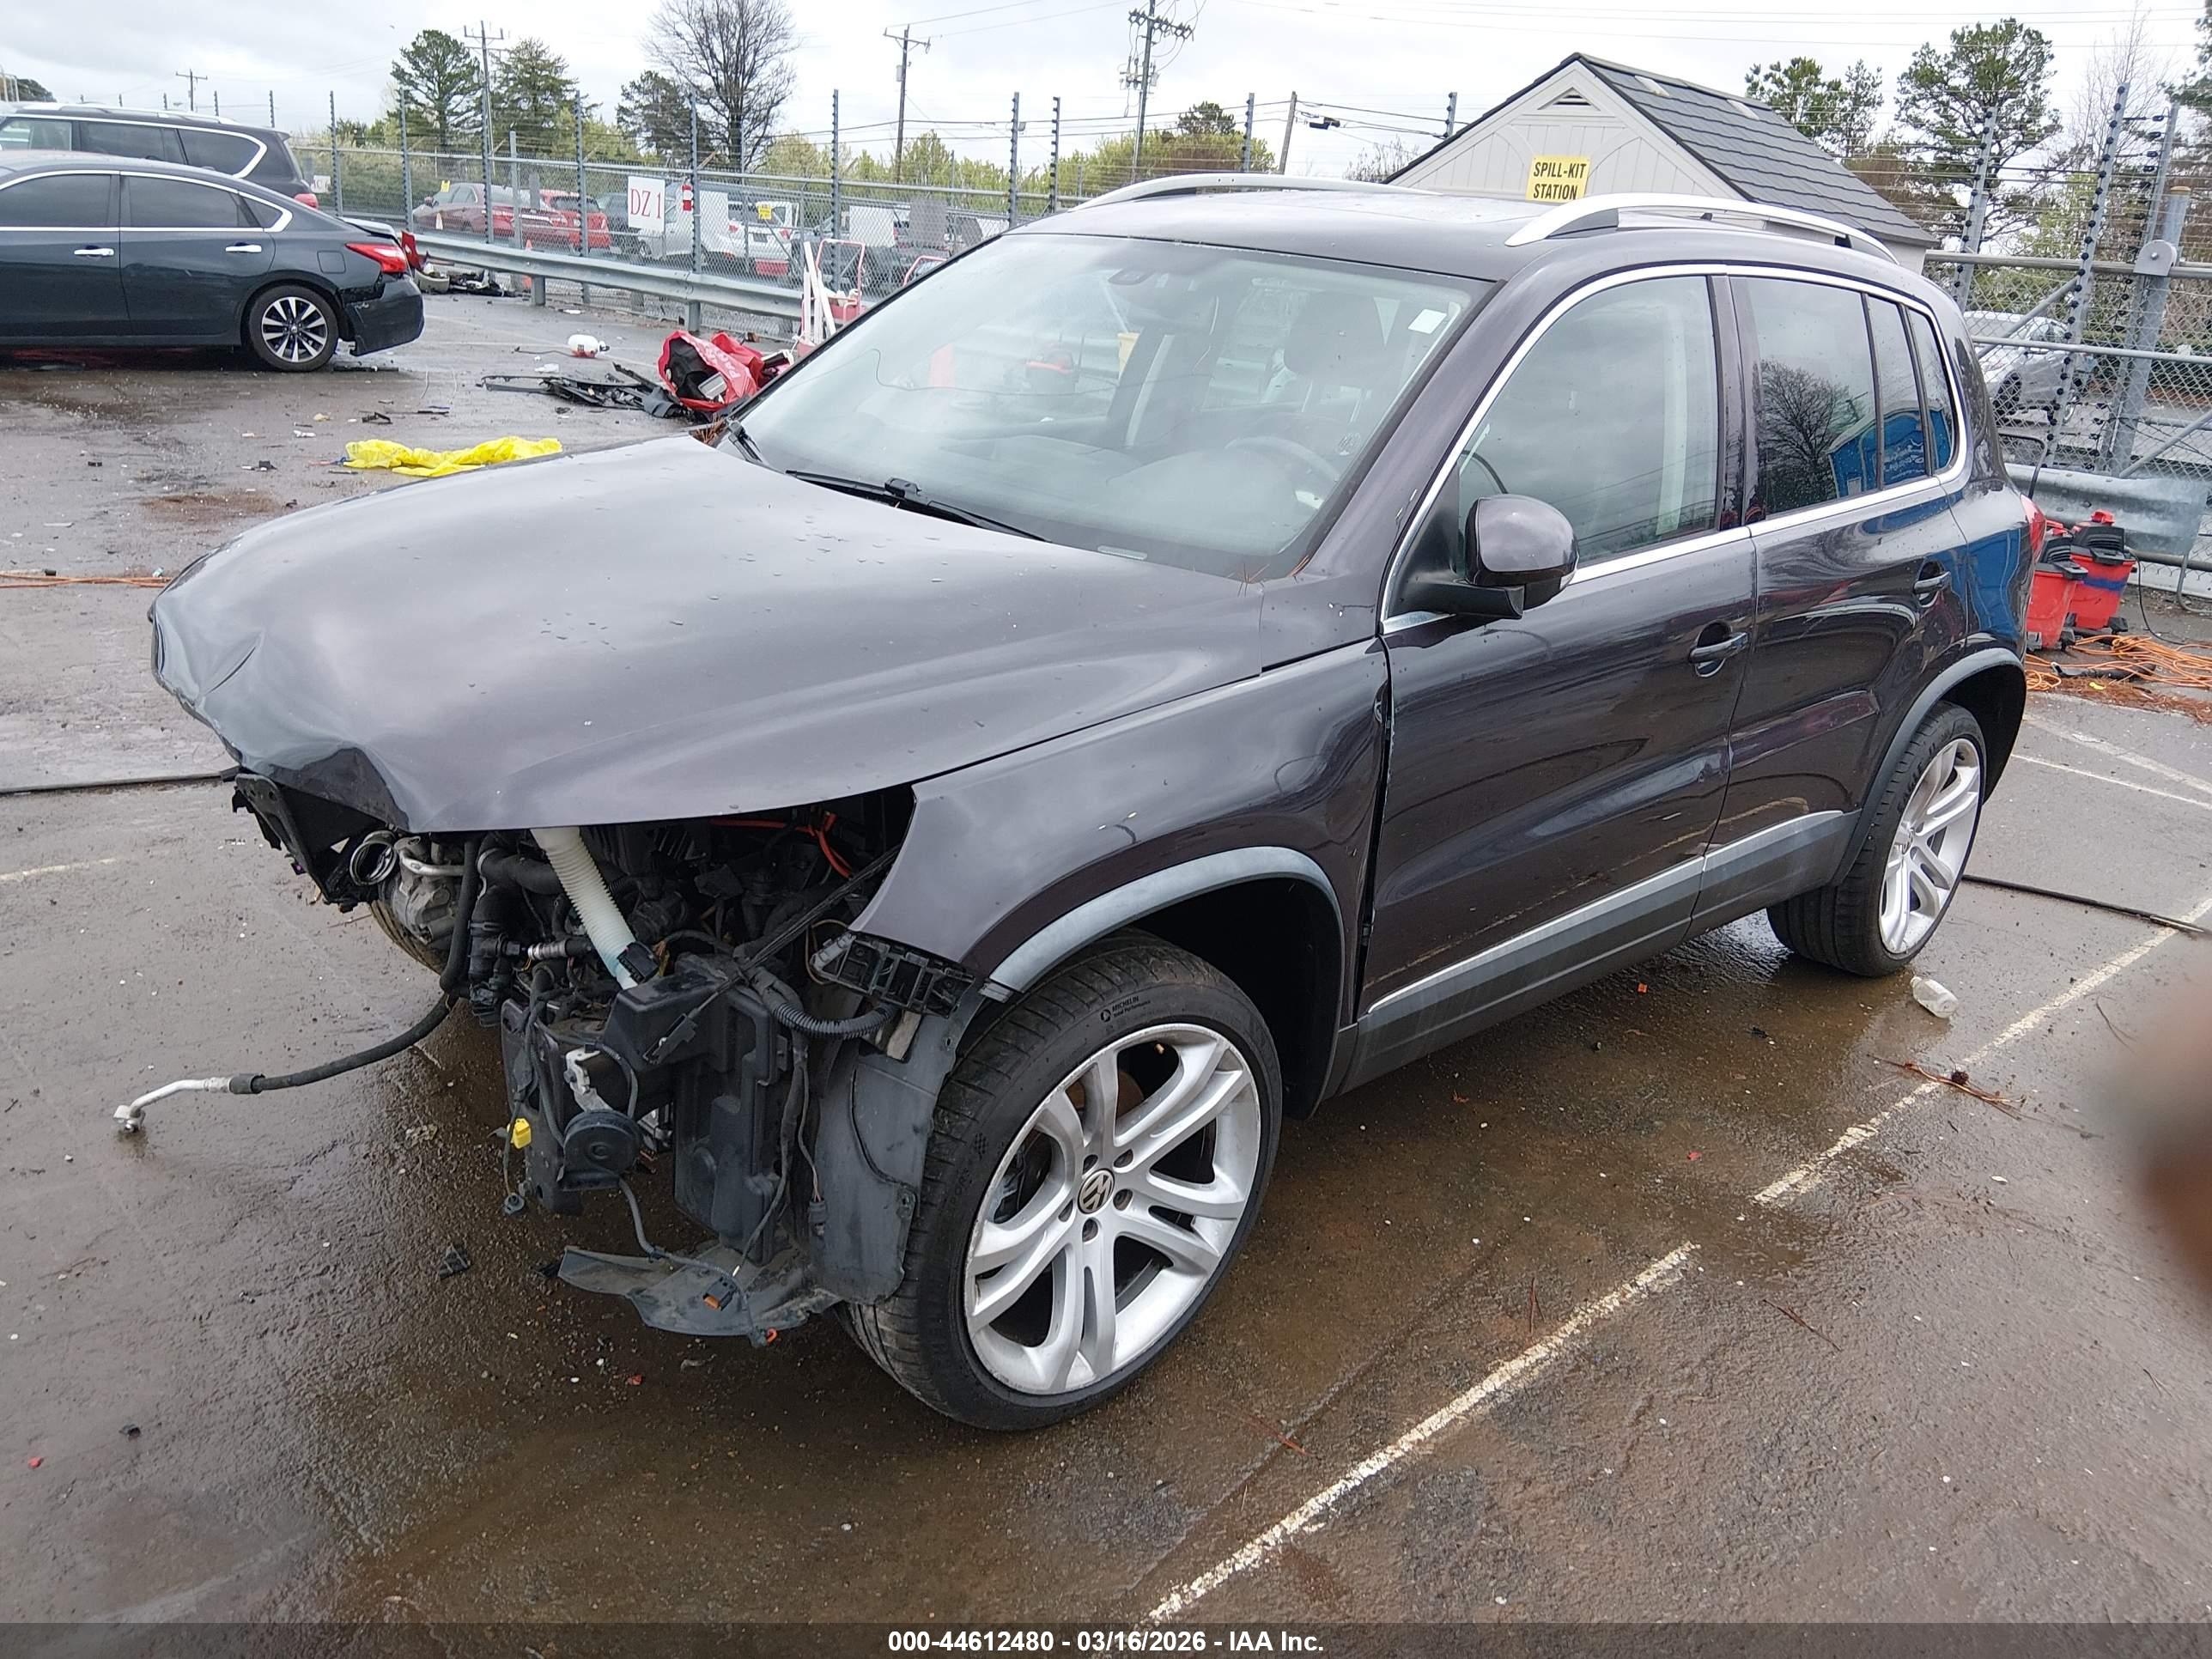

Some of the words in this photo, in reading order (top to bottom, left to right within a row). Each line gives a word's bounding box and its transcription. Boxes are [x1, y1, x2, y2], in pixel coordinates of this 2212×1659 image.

[1533, 161, 1587, 179] SPILL-KIT
[1533, 183, 1578, 200] STATION
[630, 188, 651, 217] DZ
[656, 191, 661, 220] 1
